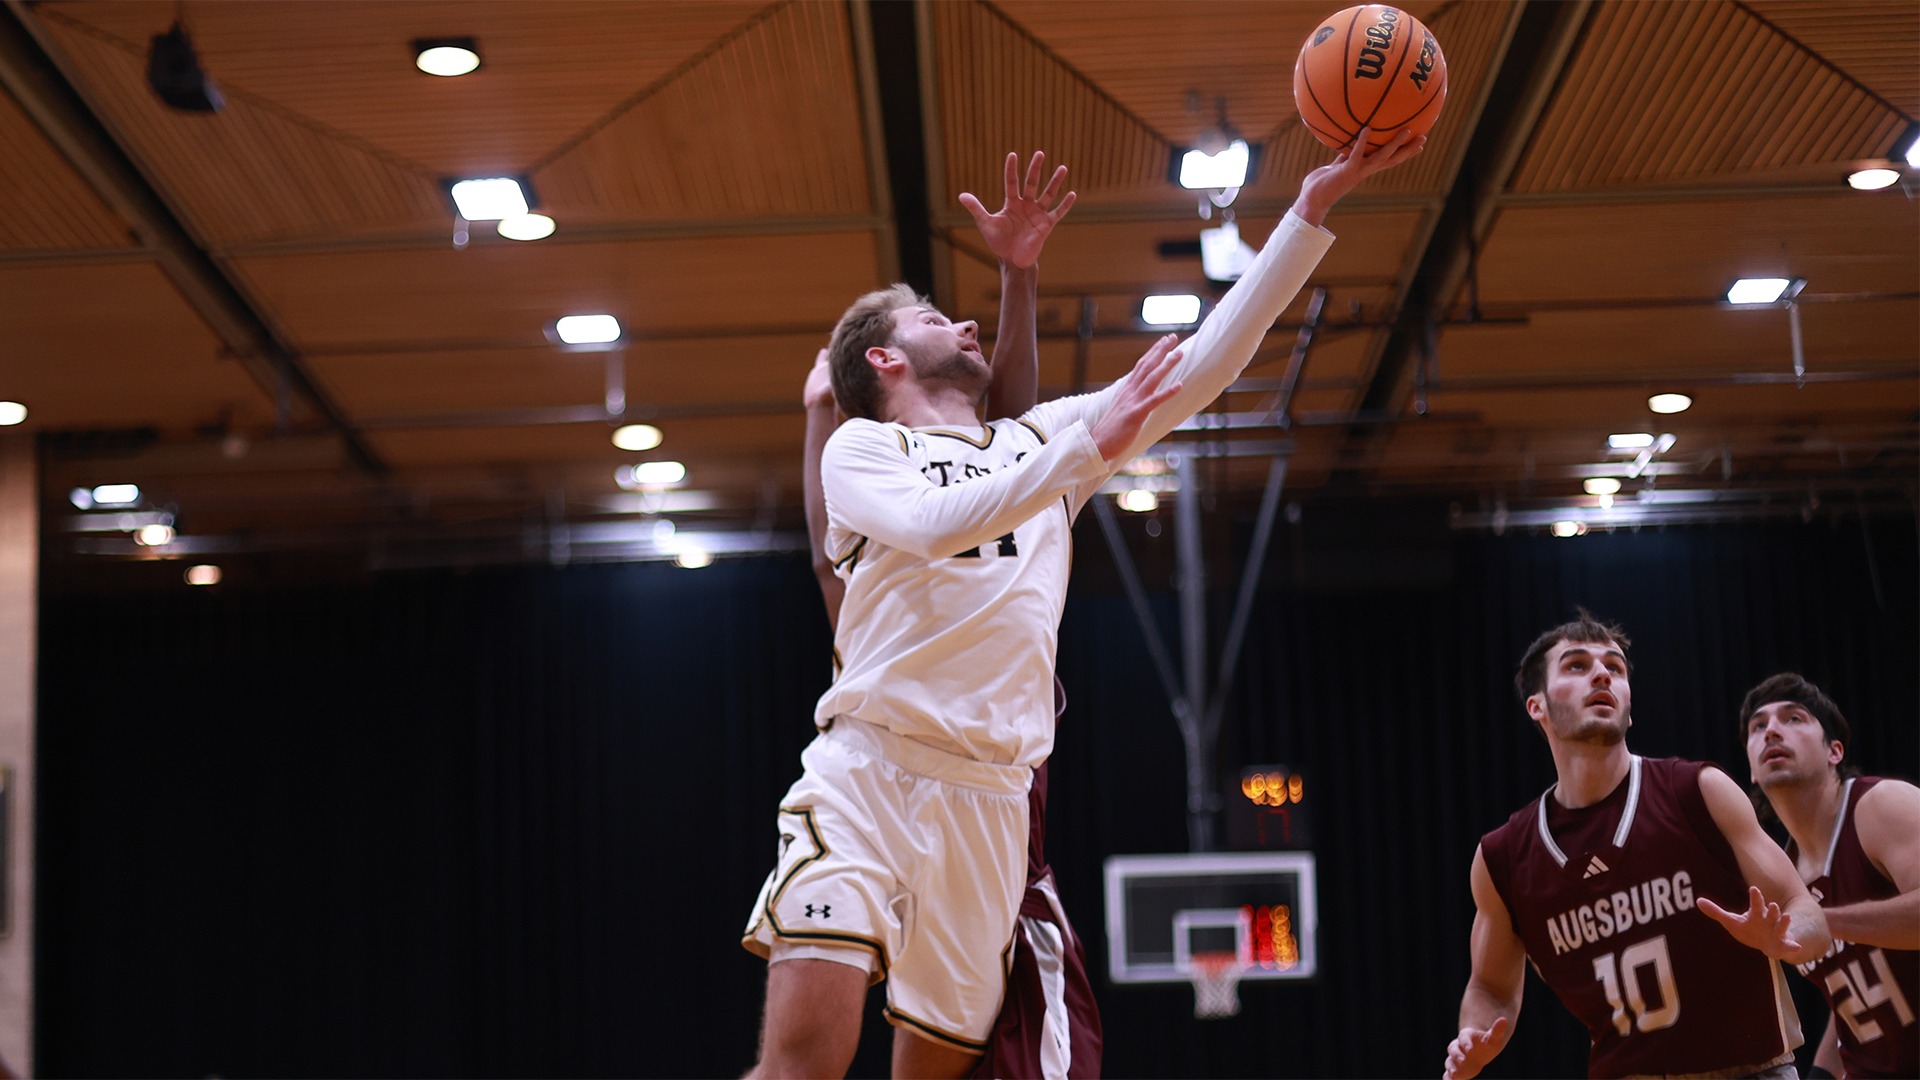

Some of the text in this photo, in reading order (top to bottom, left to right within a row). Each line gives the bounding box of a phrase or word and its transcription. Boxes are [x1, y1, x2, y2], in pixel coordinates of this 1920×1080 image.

[1355, 7, 1401, 80] Wilson
[1546, 870, 1696, 956] AUGSBURG
[1592, 934, 1681, 1037] 10
[1824, 947, 1917, 1045] 24
